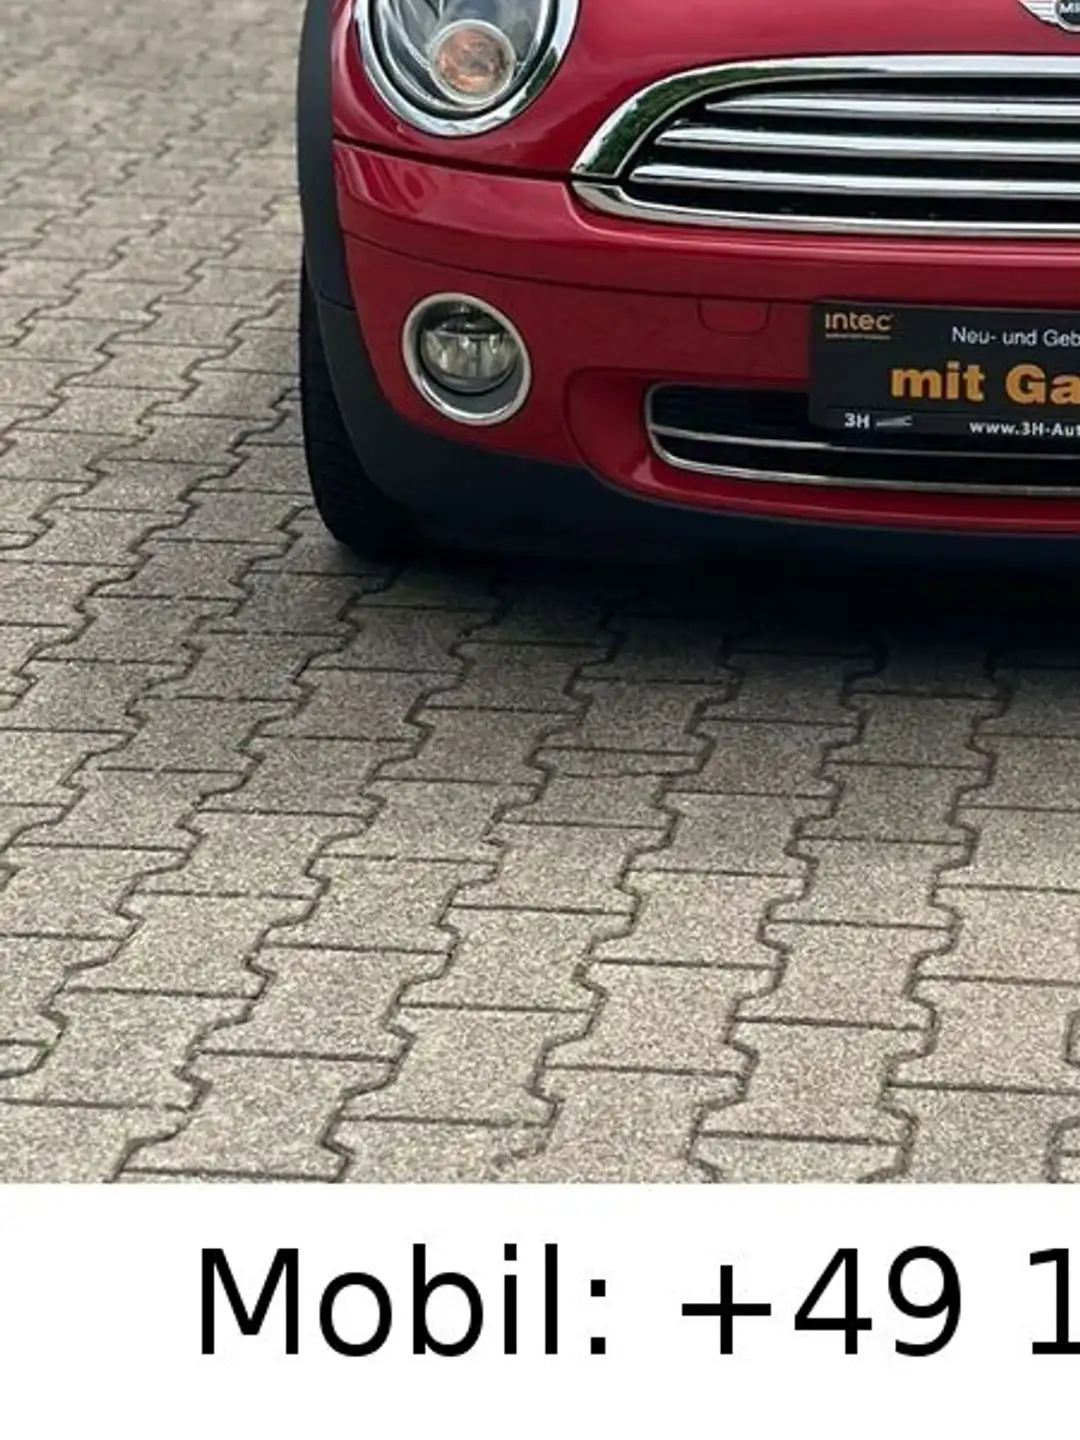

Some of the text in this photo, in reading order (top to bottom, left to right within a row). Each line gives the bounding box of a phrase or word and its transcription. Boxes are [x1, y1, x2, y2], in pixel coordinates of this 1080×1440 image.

[825, 312, 893, 331] intec
[952, 326, 997, 345] Neu-
[1002, 328, 1037, 346] und
[890, 361, 985, 401] mit
[844, 412, 871, 429] 3H
